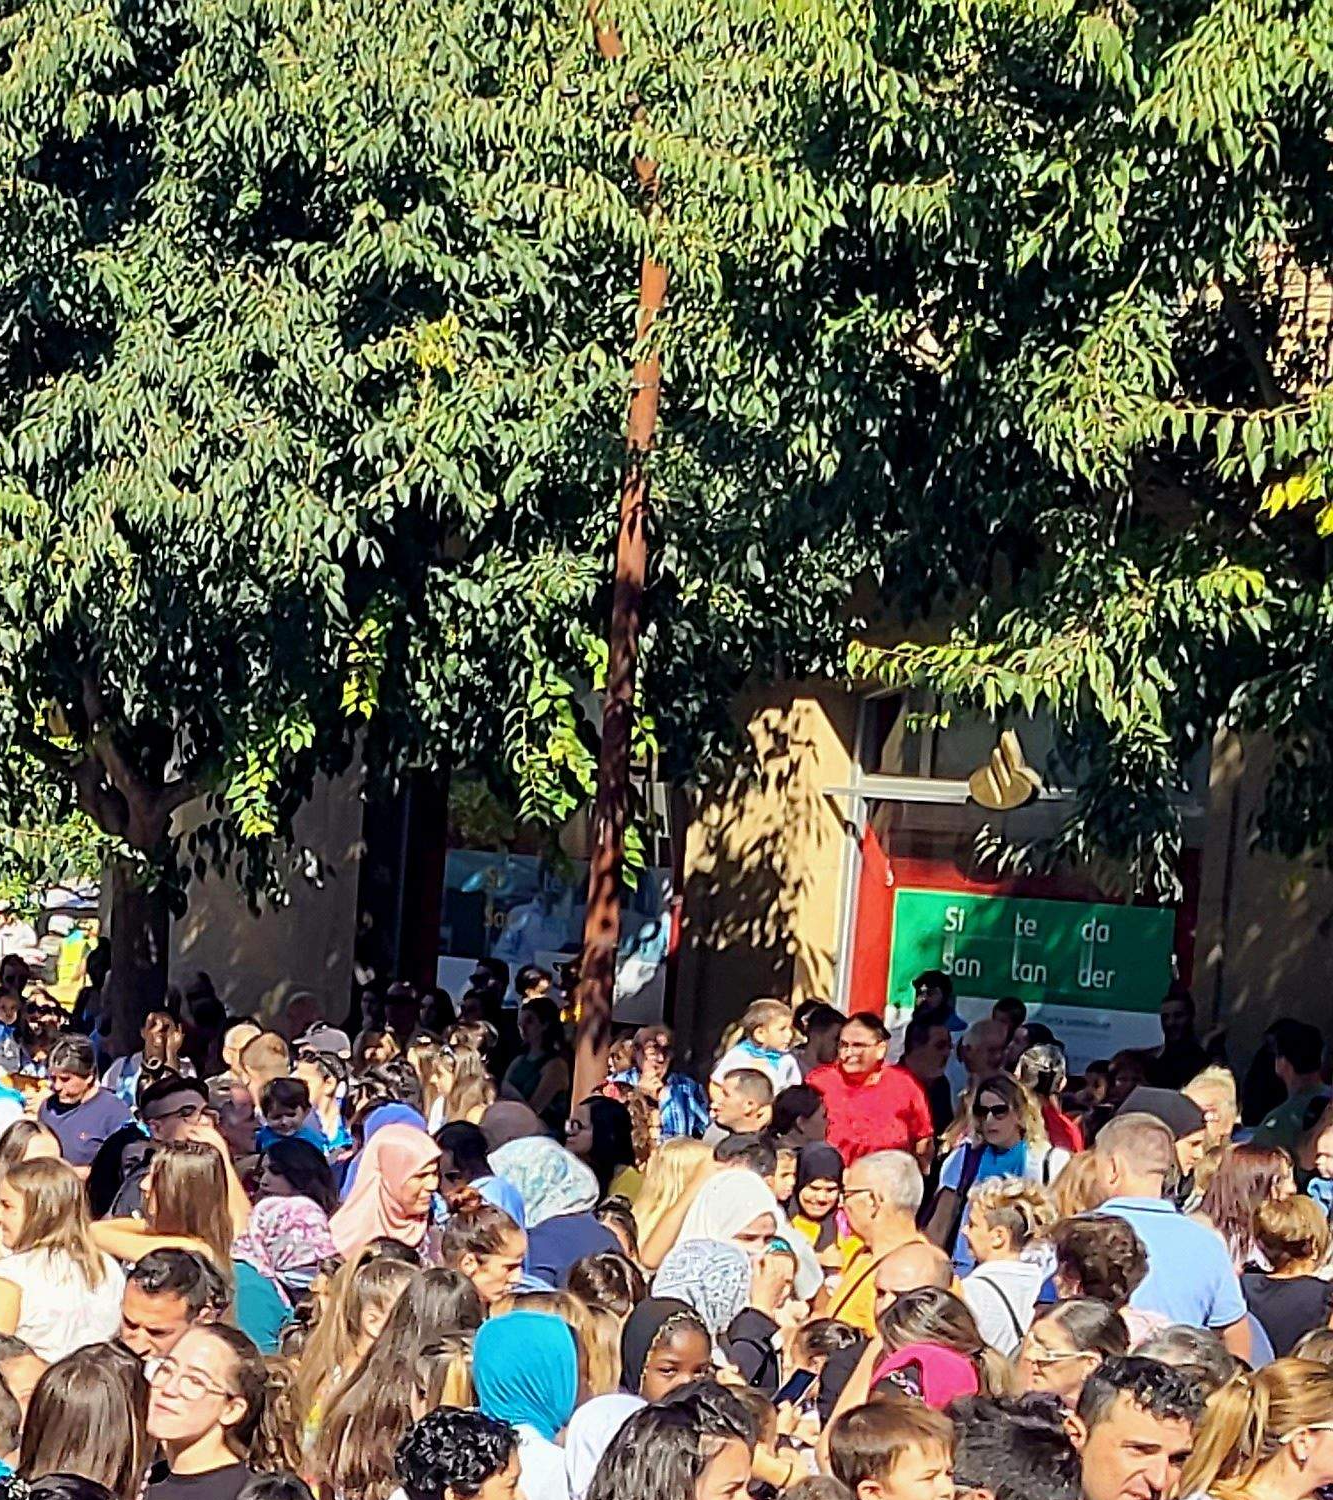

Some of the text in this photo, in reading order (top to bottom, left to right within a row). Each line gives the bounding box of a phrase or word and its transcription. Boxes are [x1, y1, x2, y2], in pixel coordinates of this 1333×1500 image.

[943, 906, 1111, 944] Si te da
[941, 952, 1116, 989] San tan der
